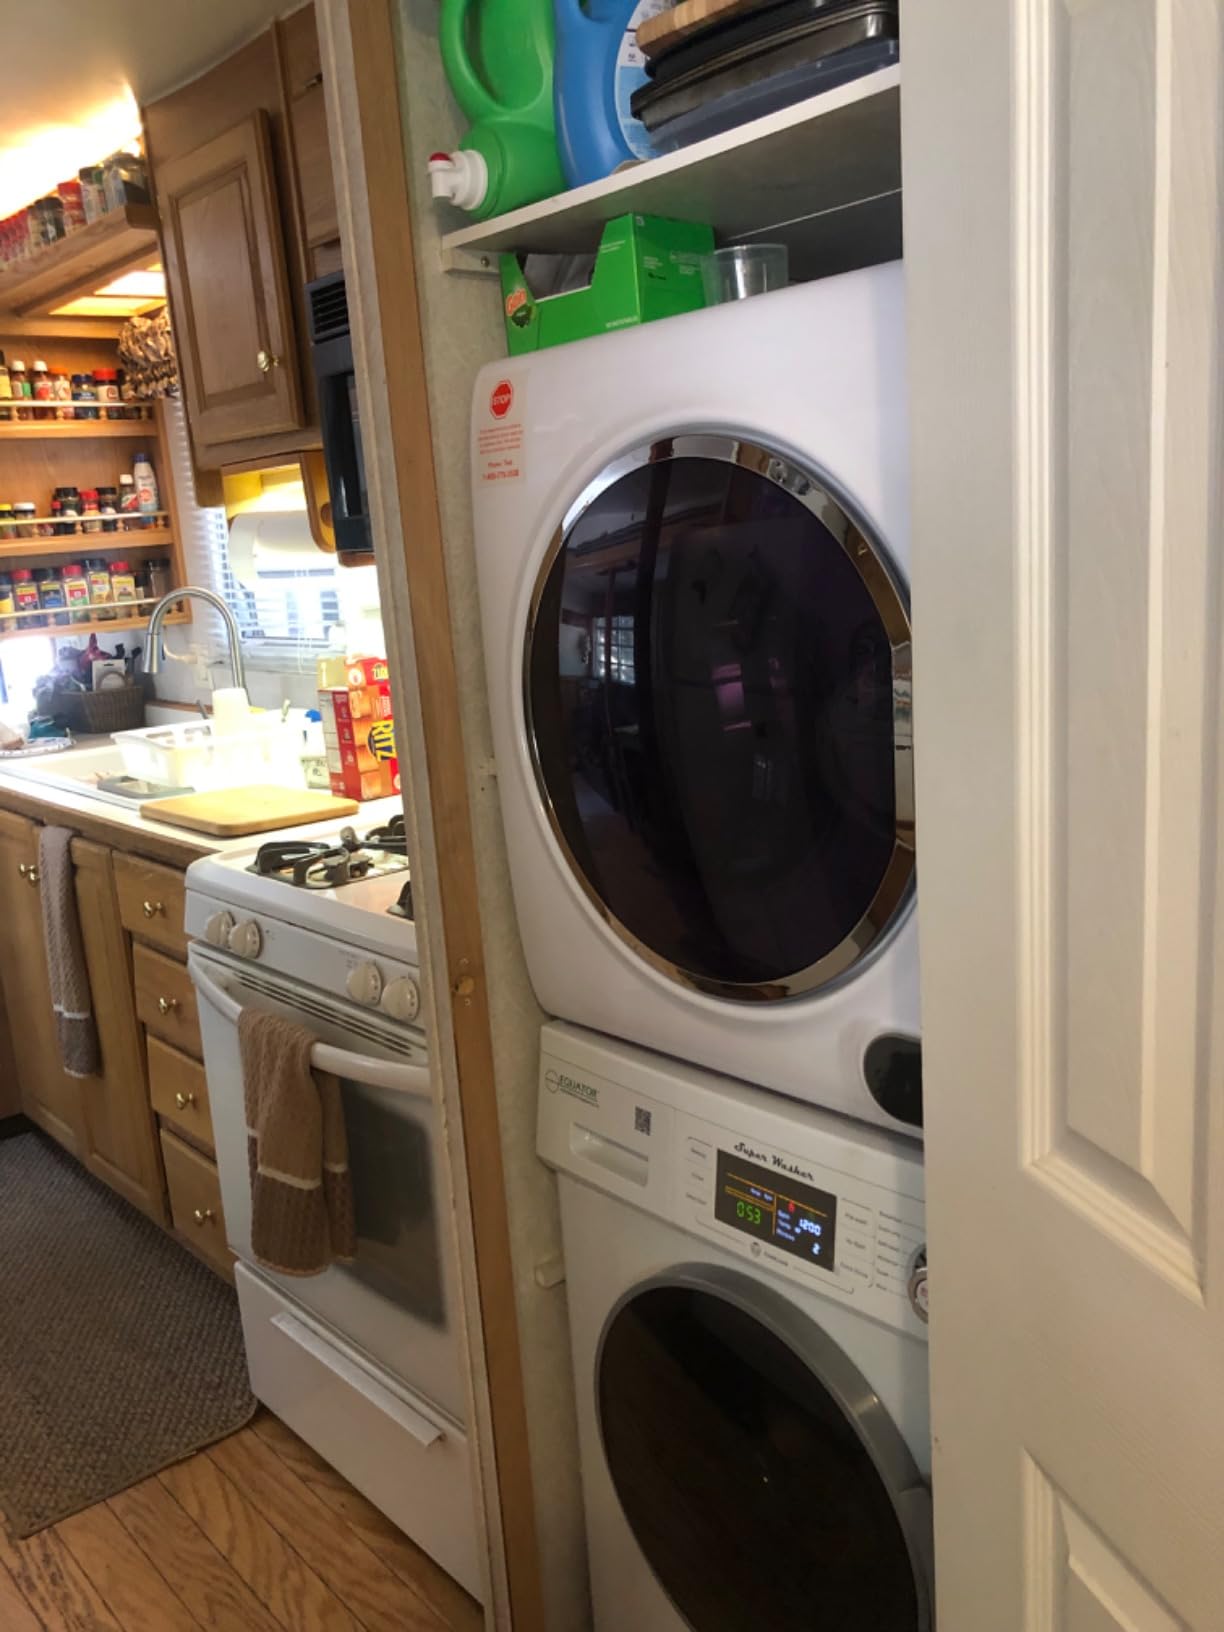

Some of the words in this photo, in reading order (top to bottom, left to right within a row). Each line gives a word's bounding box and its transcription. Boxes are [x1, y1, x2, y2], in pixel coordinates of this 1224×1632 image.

[493, 394, 511, 406] STOP
[371, 720, 397, 762] RITZ
[733, 1141, 768, 1163] Super
[771, 1154, 815, 1182] Washer
